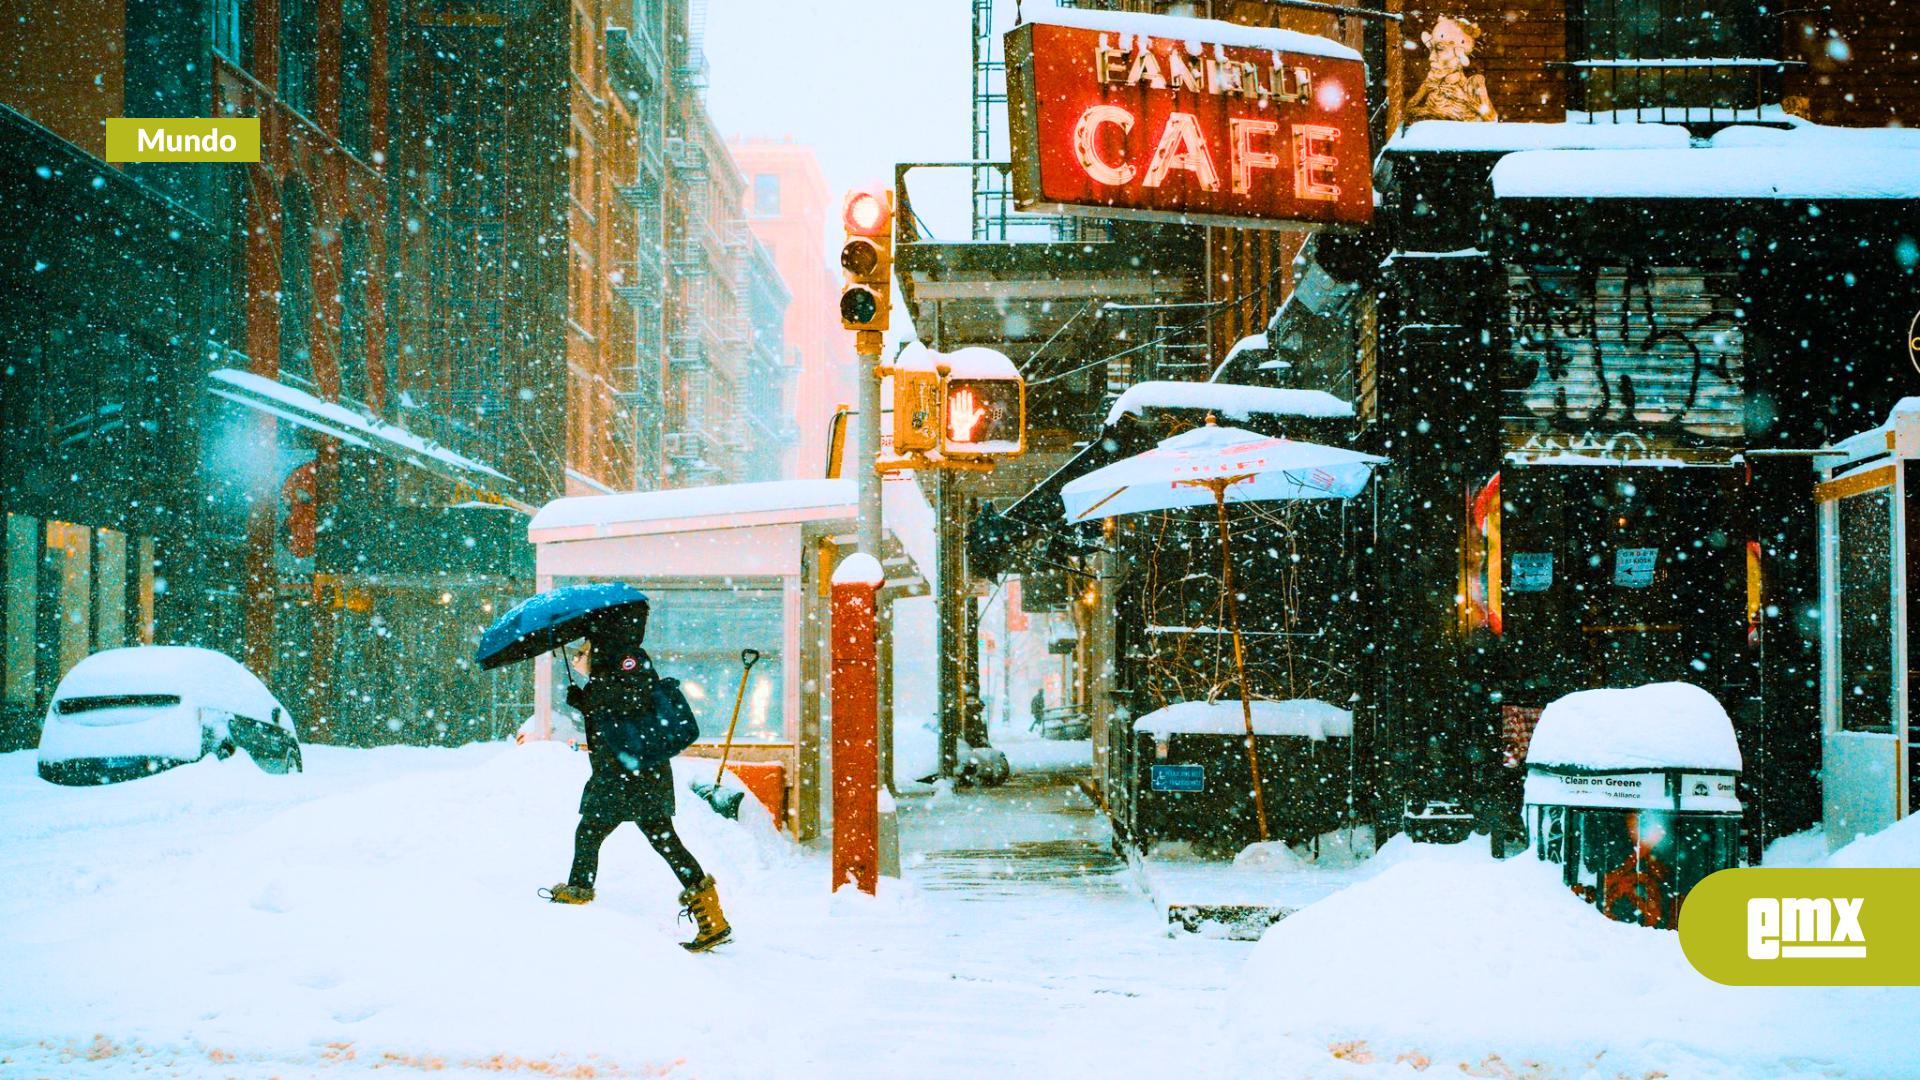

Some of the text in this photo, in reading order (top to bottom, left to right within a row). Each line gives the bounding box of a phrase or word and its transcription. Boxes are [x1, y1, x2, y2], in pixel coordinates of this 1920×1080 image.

[1073, 104, 1341, 201] CAFE
[1565, 776, 1588, 785] Clean
[1591, 778, 1603, 786] on
[1605, 778, 1642, 788] Greene
[1613, 791, 1641, 799] Alliance
